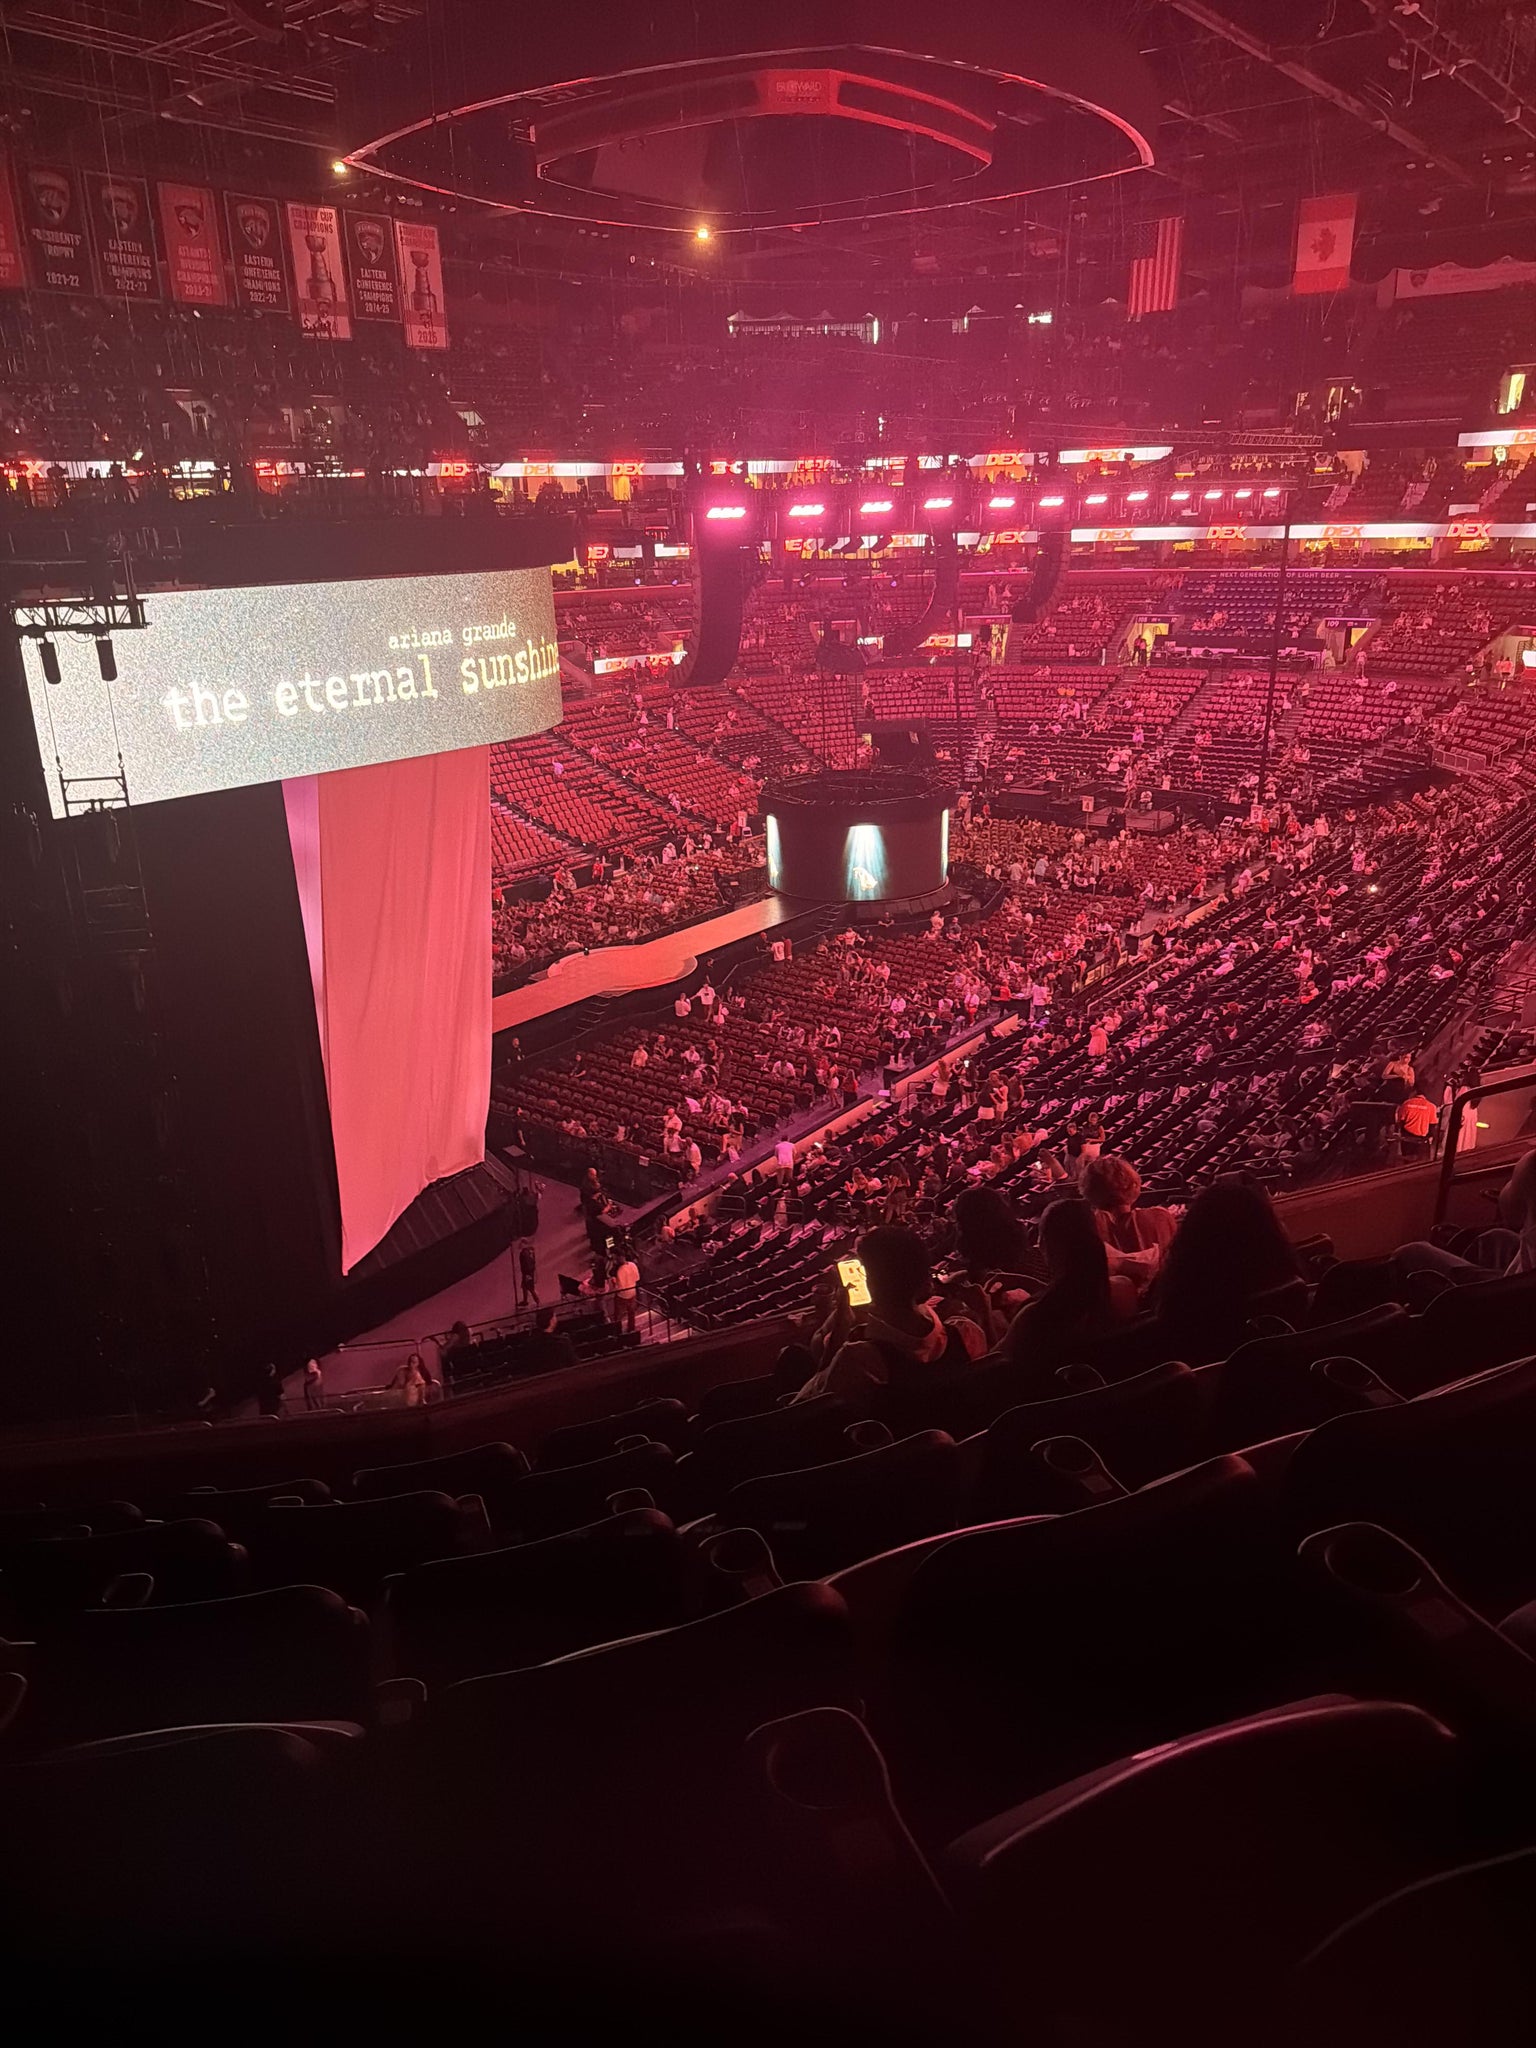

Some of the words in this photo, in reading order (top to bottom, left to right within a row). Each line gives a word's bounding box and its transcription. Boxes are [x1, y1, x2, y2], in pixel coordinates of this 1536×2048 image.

[1515, 432, 1536, 447] DE
[985, 453, 1024, 467] DEX
[612, 463, 645, 476] DEX
[1097, 530, 1134, 541] DEX
[1207, 526, 1248, 540] DEX
[1323, 526, 1364, 537] DEX
[1447, 523, 1493, 538] DEX
[388, 625, 453, 650] ariana
[462, 613, 516, 647] grande
[161, 681, 250, 730] the
[275, 654, 438, 717] eternal
